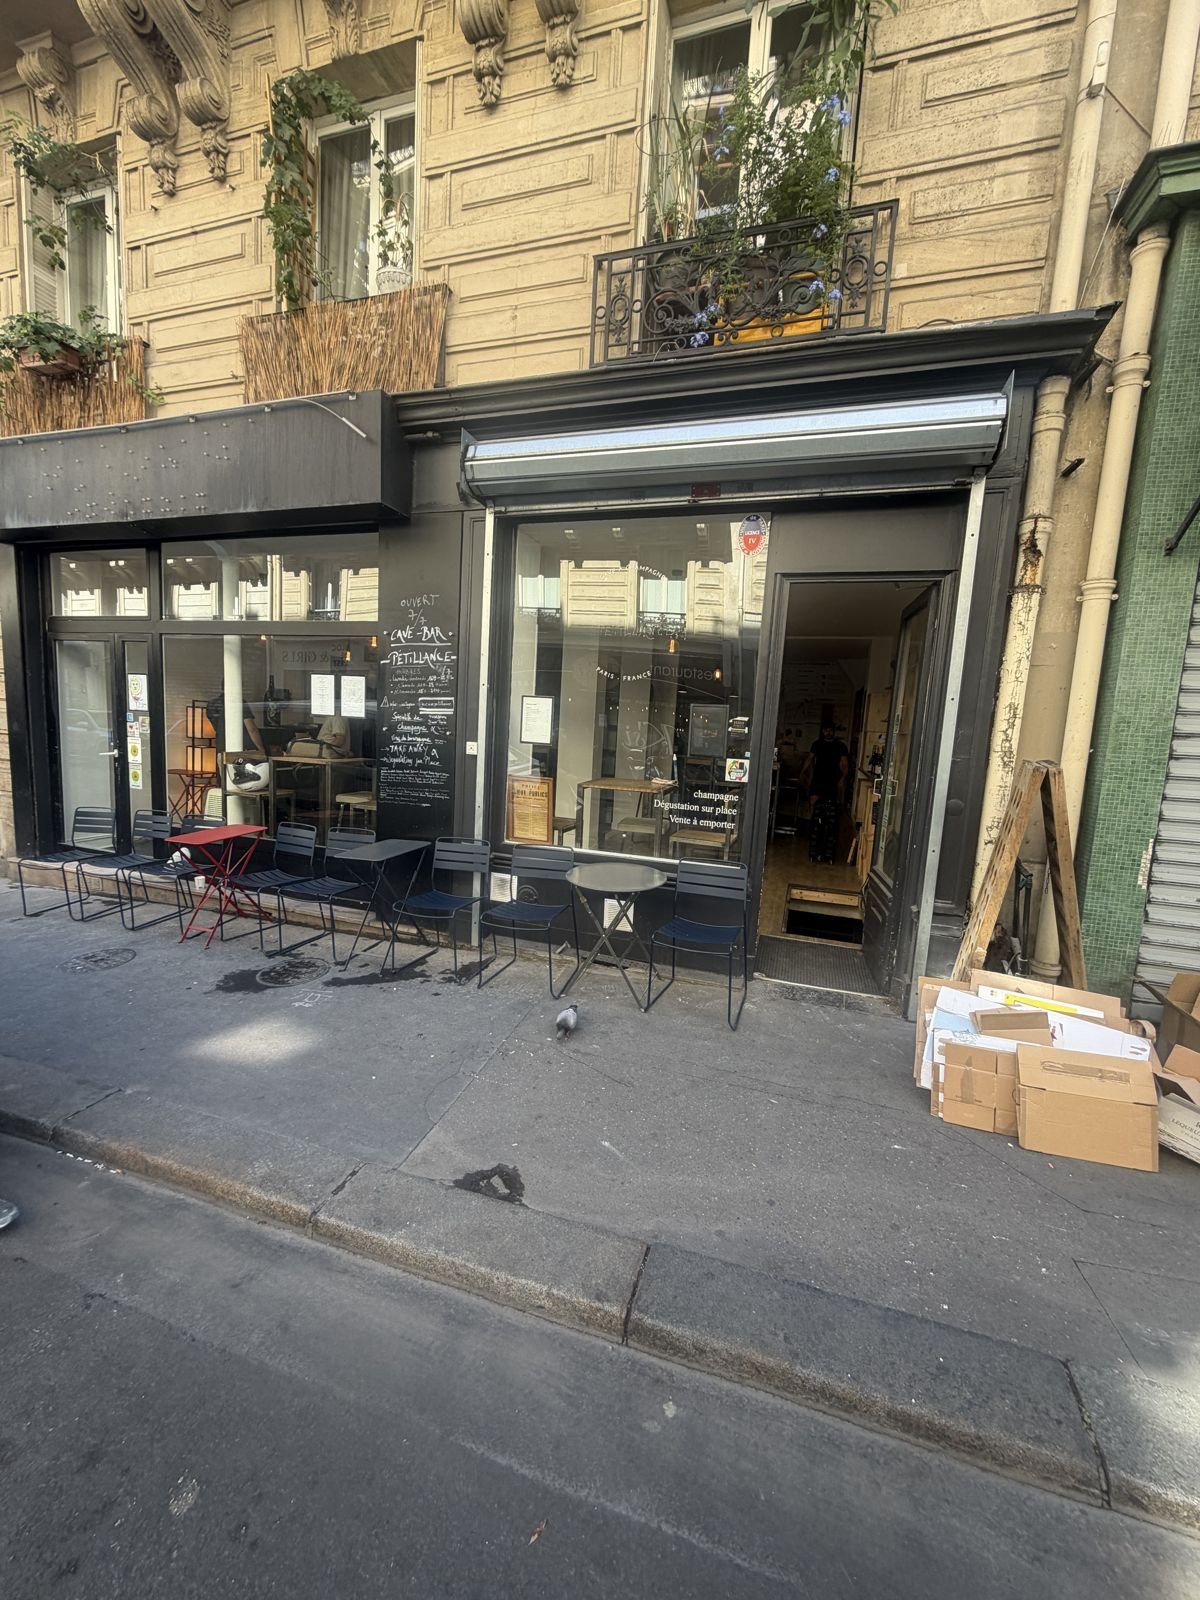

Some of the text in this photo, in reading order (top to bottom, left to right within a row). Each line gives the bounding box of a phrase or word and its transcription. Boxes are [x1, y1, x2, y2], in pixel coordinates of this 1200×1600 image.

[400, 594, 440, 607] OUVERT
[596, 666, 652, 681] PARIS FRANCE
[693, 789, 739, 803] champagne
[653, 799, 738, 815] Dégustation sur place
[669, 814, 736, 830] Vente à emporter
